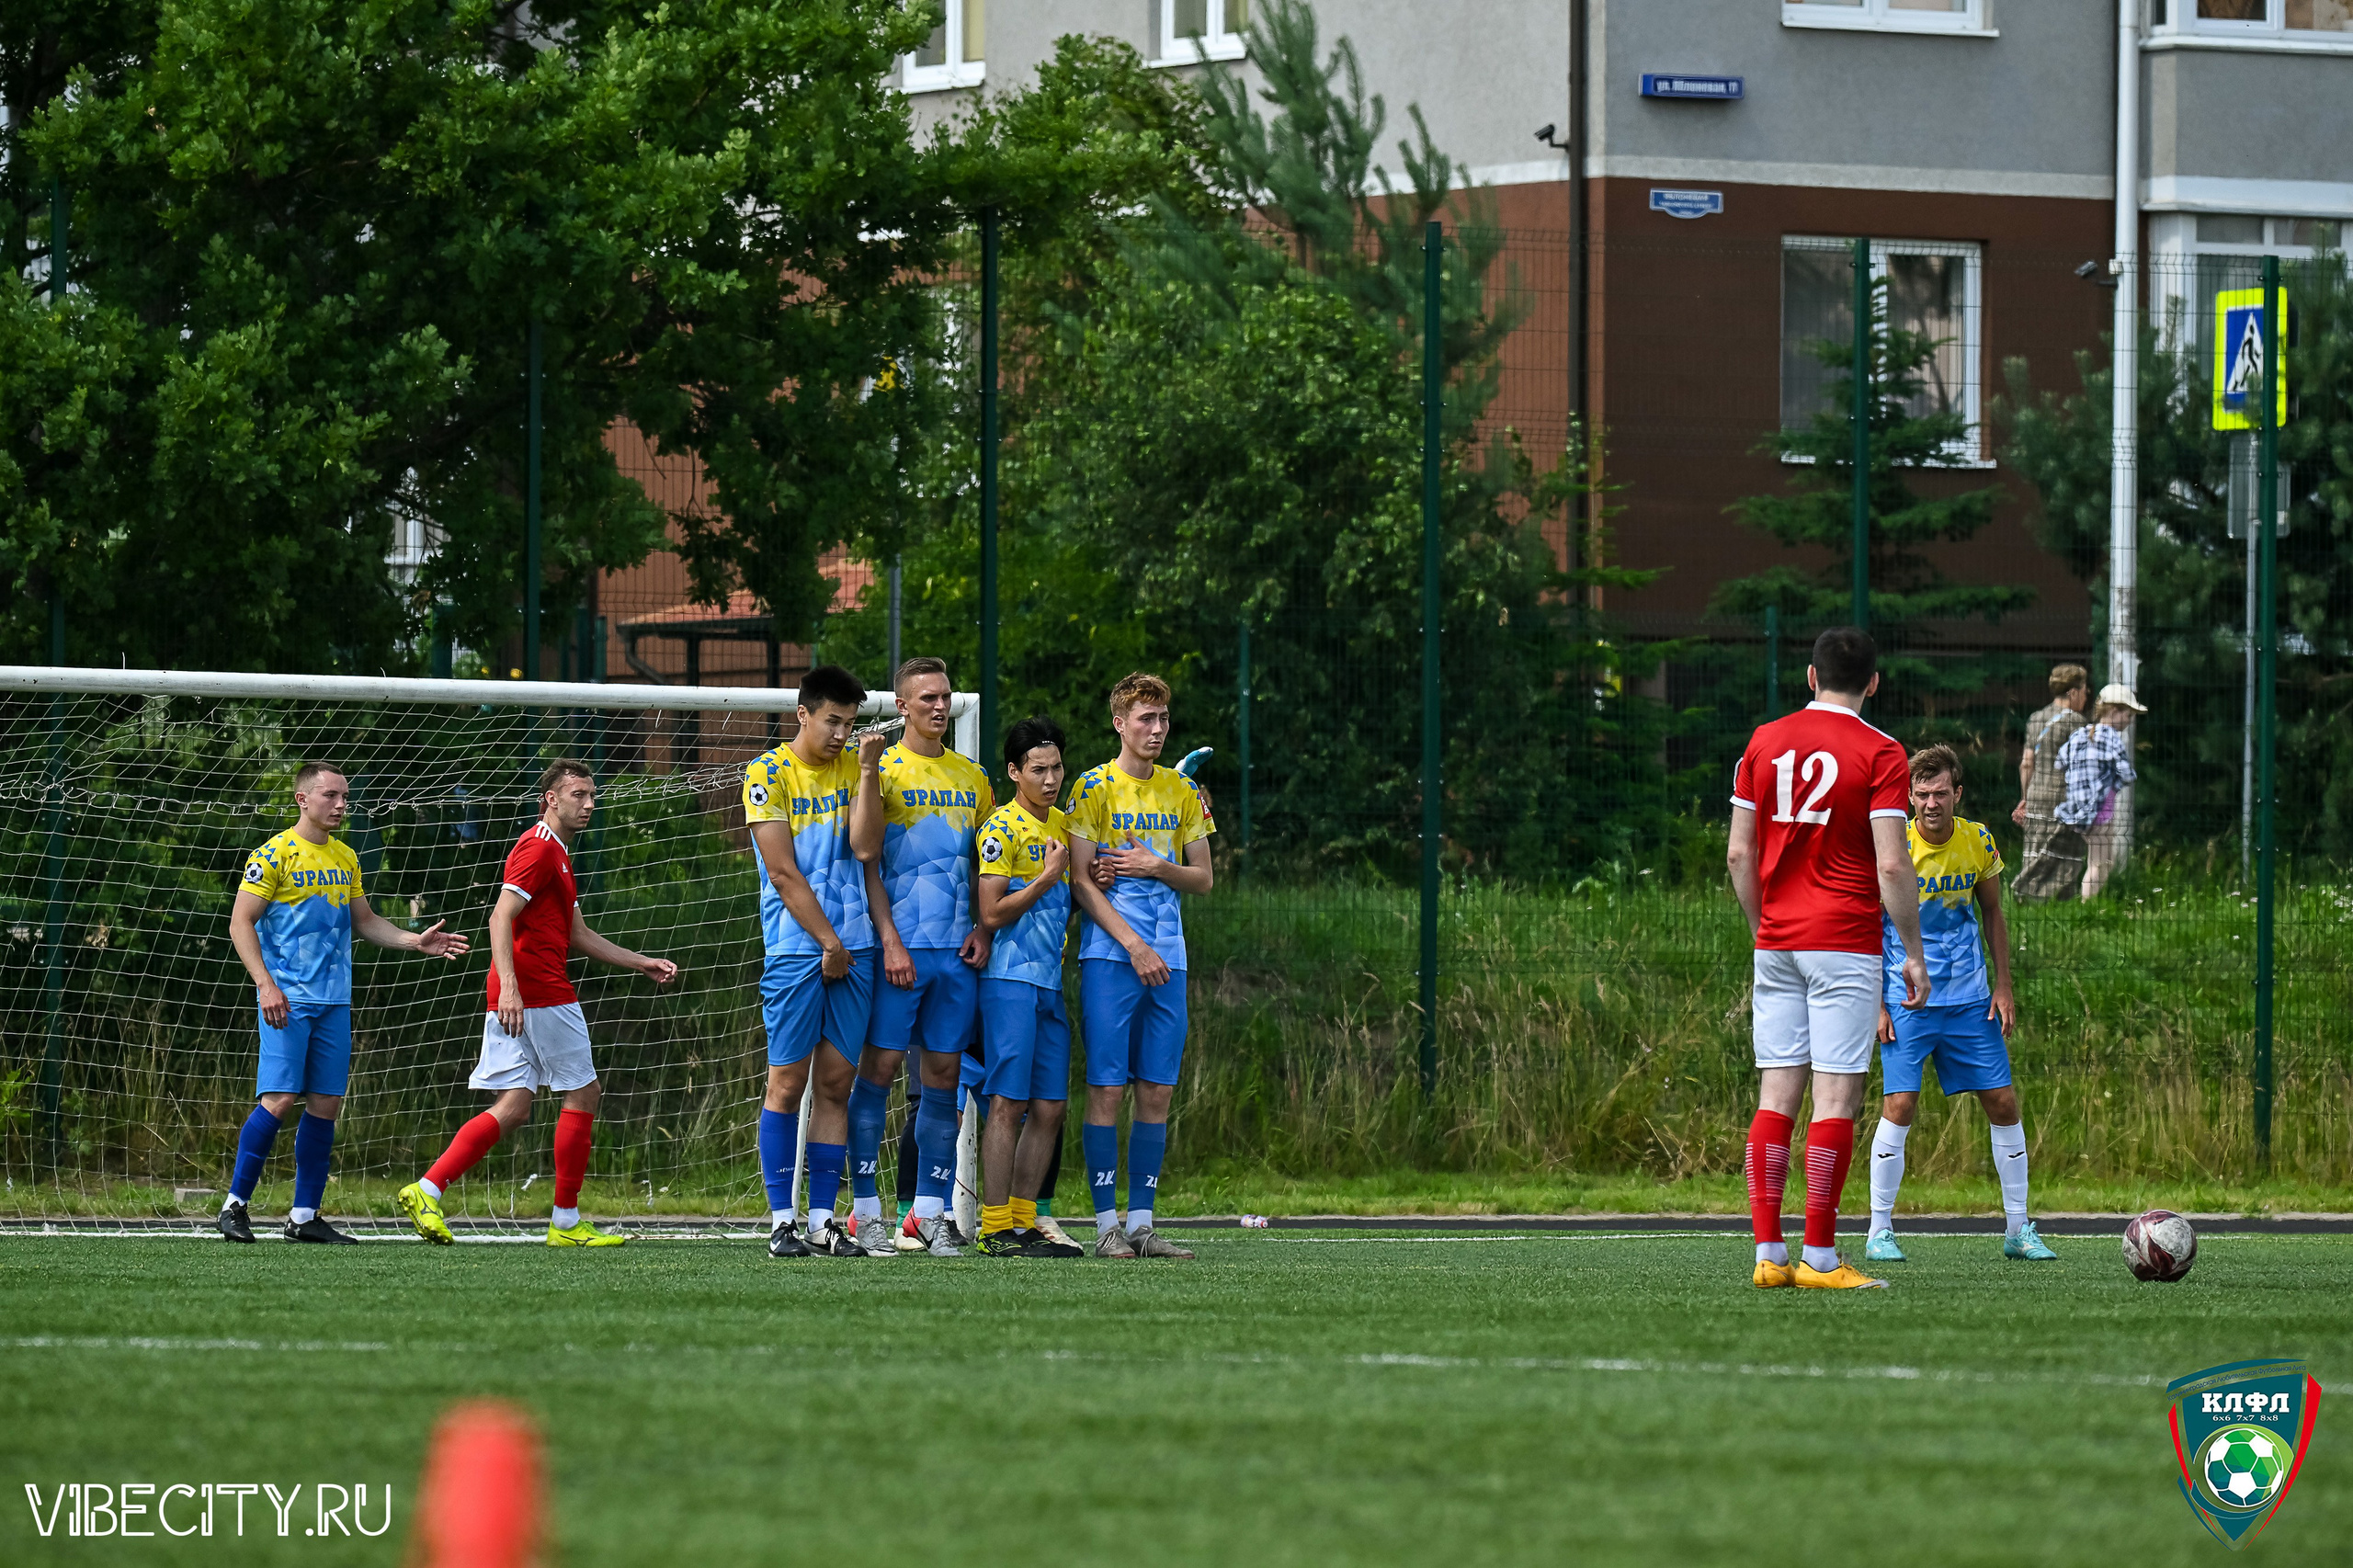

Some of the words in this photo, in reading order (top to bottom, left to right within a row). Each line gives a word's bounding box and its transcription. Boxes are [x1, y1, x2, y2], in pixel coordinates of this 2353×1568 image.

[1771, 749, 1838, 825] 12
[902, 790, 976, 809] УРАЛАН
[1111, 812, 1179, 831] УРАЛАН
[1916, 872, 1976, 893] РАЛАН
